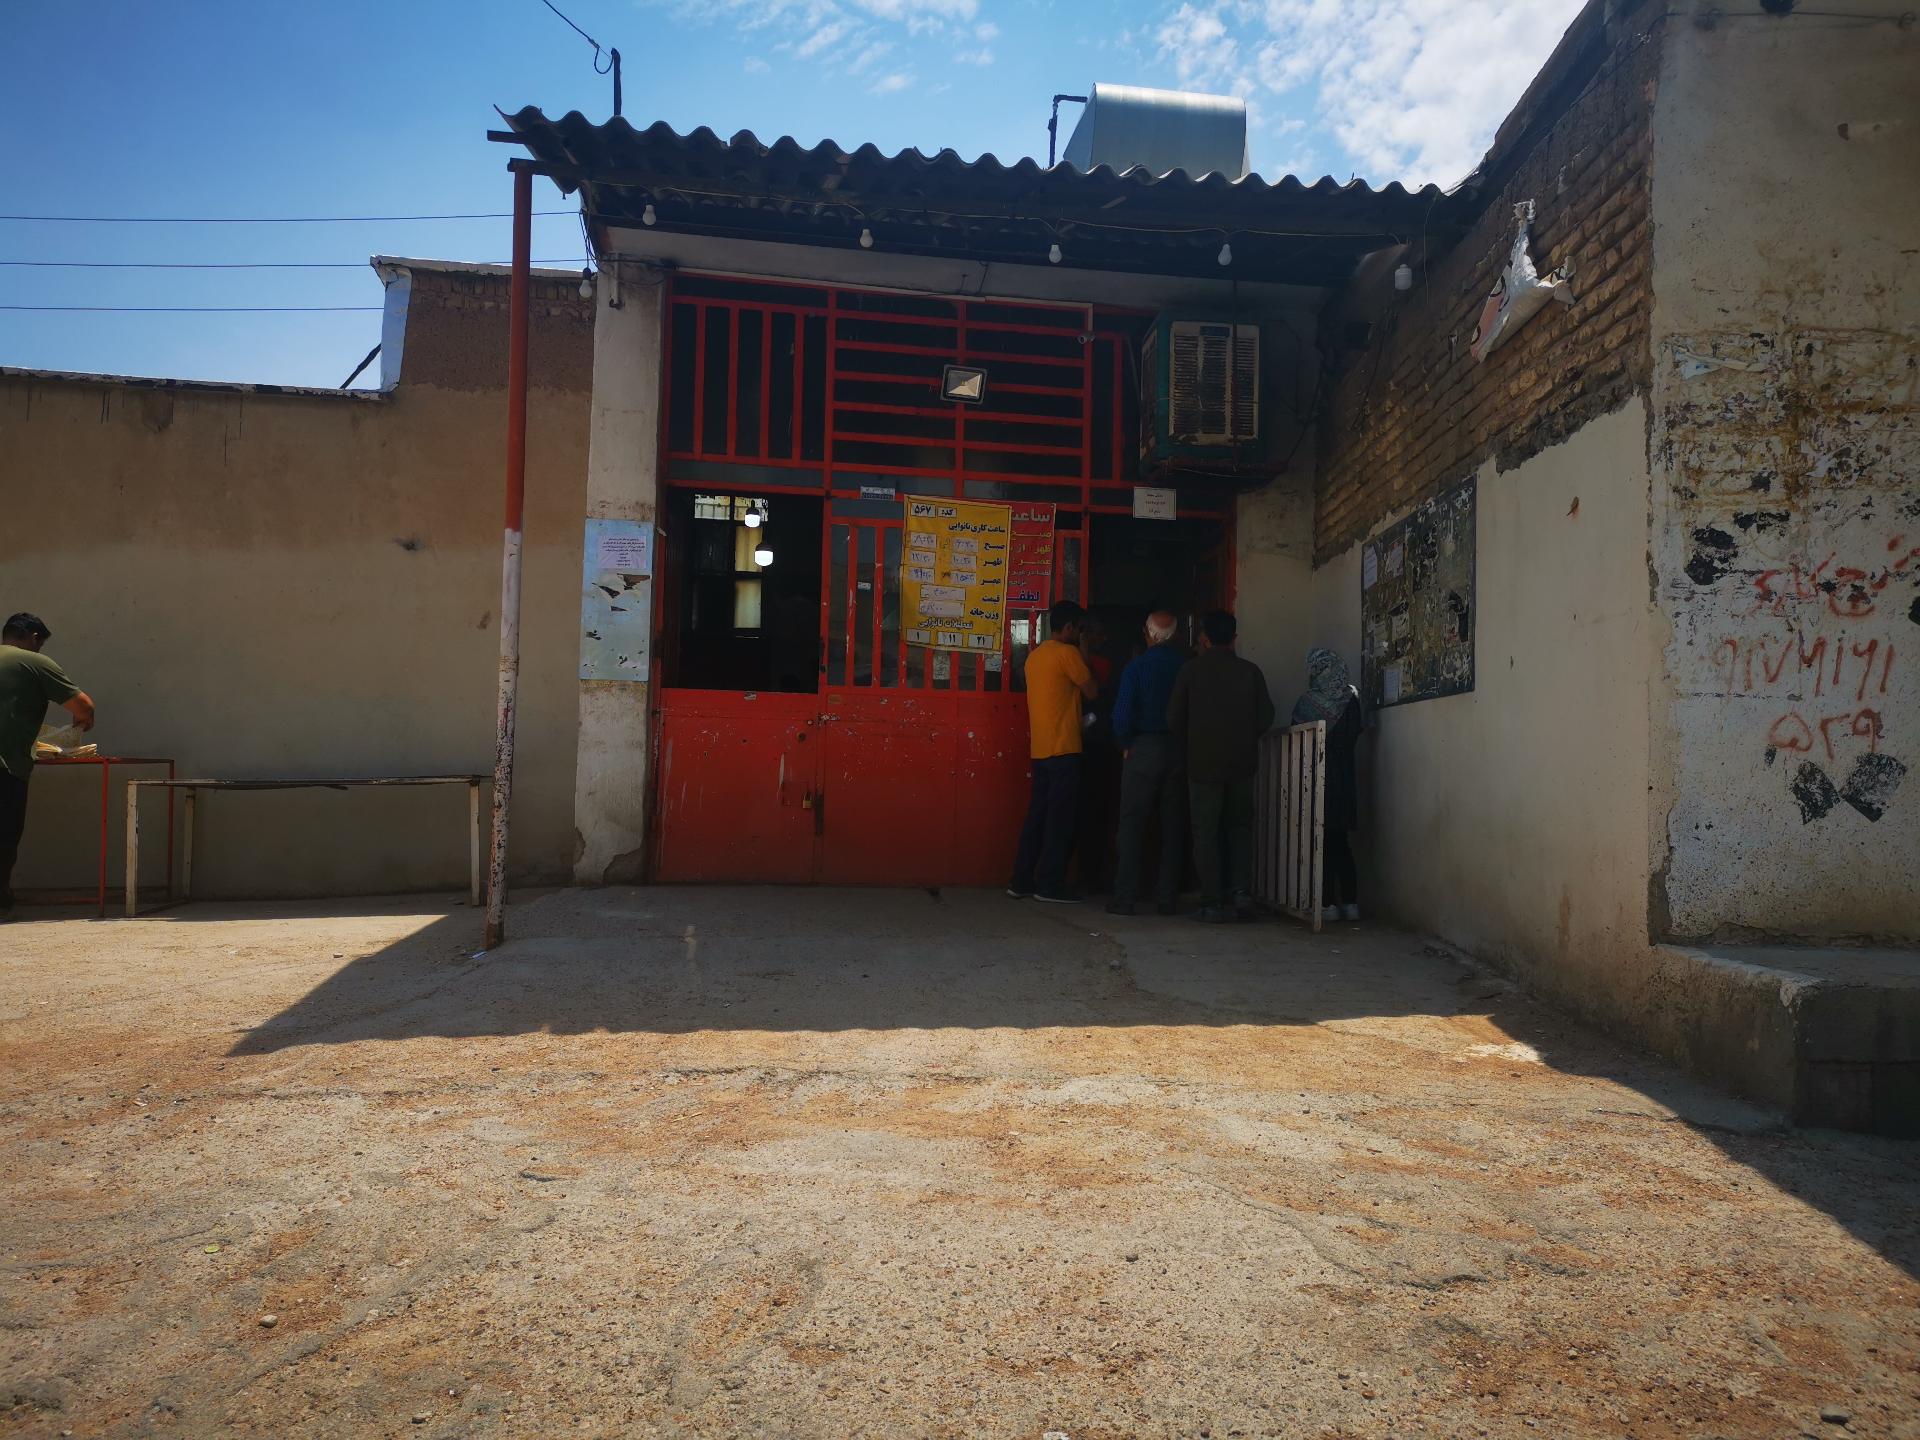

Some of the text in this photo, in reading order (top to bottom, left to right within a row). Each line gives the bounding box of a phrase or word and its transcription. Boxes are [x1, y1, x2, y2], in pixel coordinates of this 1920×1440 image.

[948, 520, 1006, 534] ساعت کاری نانوایی
[984, 542, 1006, 551] صبح
[983, 558, 1002, 567] ظهر
[982, 594, 1001, 605] قیمت
